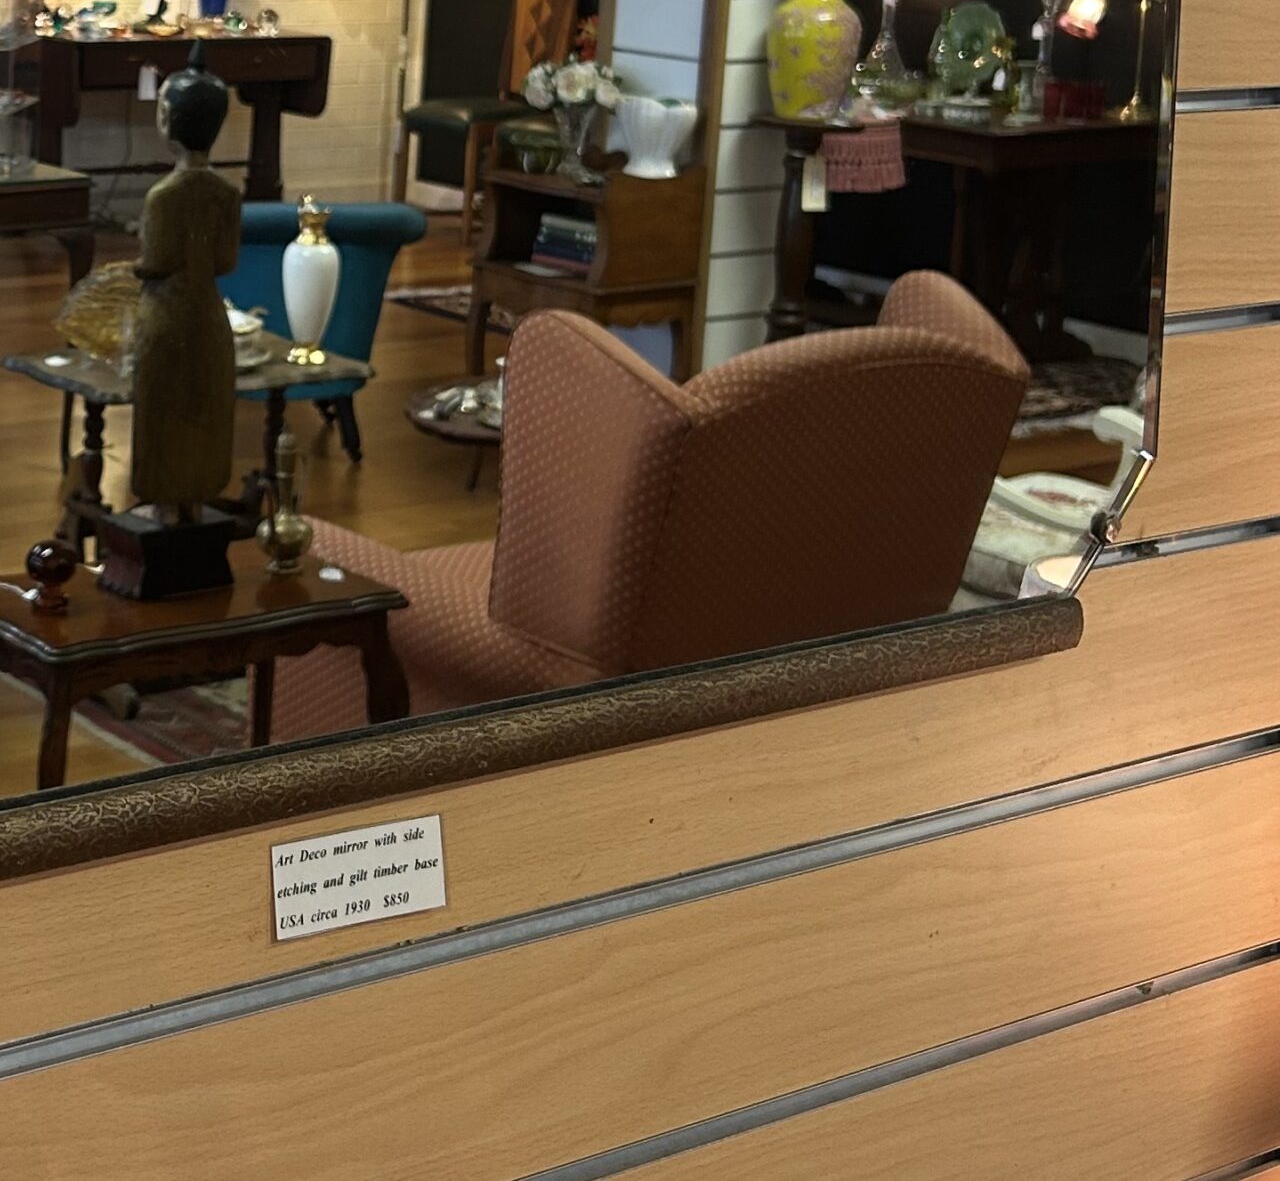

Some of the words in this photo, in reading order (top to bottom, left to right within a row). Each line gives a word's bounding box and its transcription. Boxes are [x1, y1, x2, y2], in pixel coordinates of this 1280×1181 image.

[275, 854, 294, 868] Art
[300, 848, 327, 862] Deco
[333, 840, 368, 856] mirror
[375, 832, 397, 847] with
[403, 828, 424, 842] side
[277, 882, 317, 898] etching
[323, 873, 344, 888] and
[349, 870, 368, 886] gilt
[373, 863, 408, 878] timber
[415, 857, 438, 870] base
[280, 913, 304, 929] USA
[311, 907, 337, 923] circa
[345, 899, 371, 915] 1930
[384, 891, 409, 908] $850
